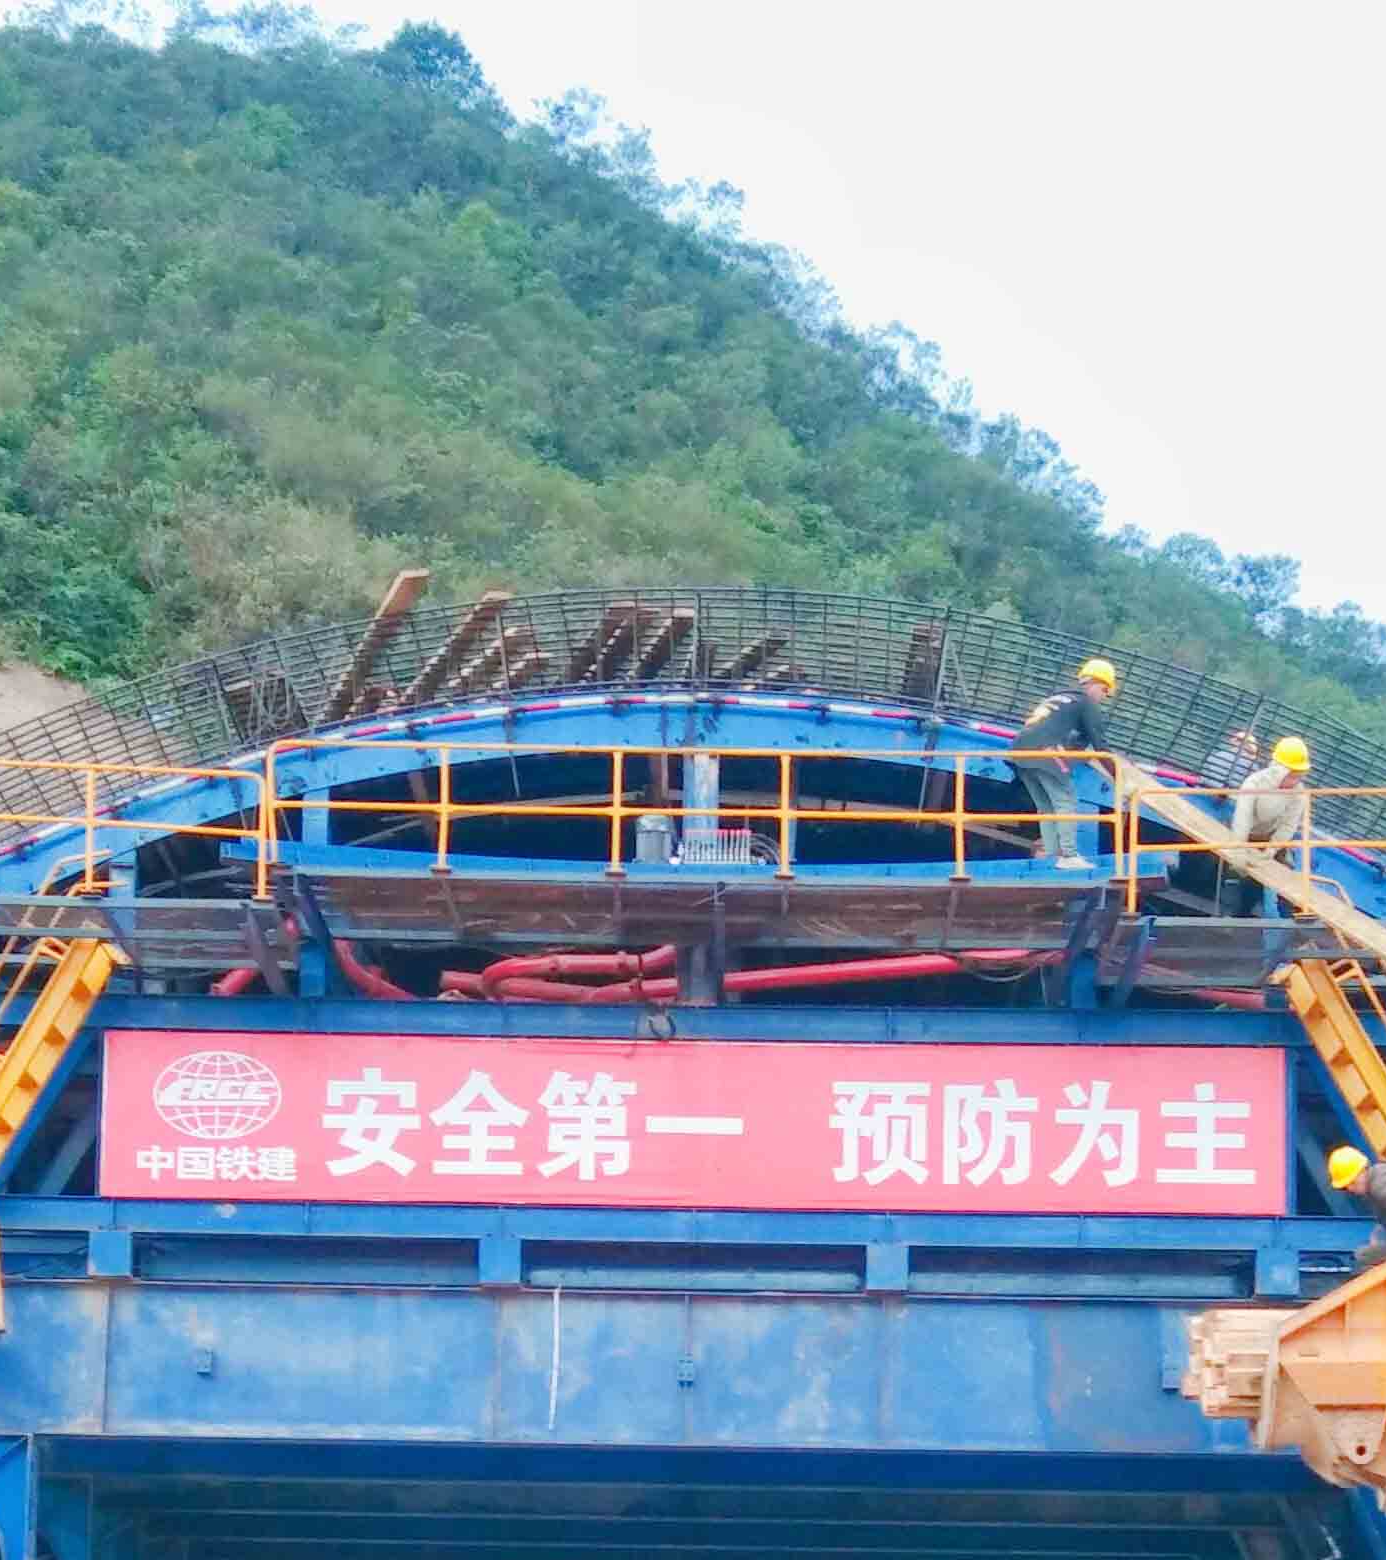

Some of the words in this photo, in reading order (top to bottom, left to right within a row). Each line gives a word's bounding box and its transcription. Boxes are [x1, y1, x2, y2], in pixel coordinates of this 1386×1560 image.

[136, 1145, 297, 1181] 中国铁建
[322, 1067, 744, 1181] 安全第一
[828, 1078, 1257, 1187] 预防为主
